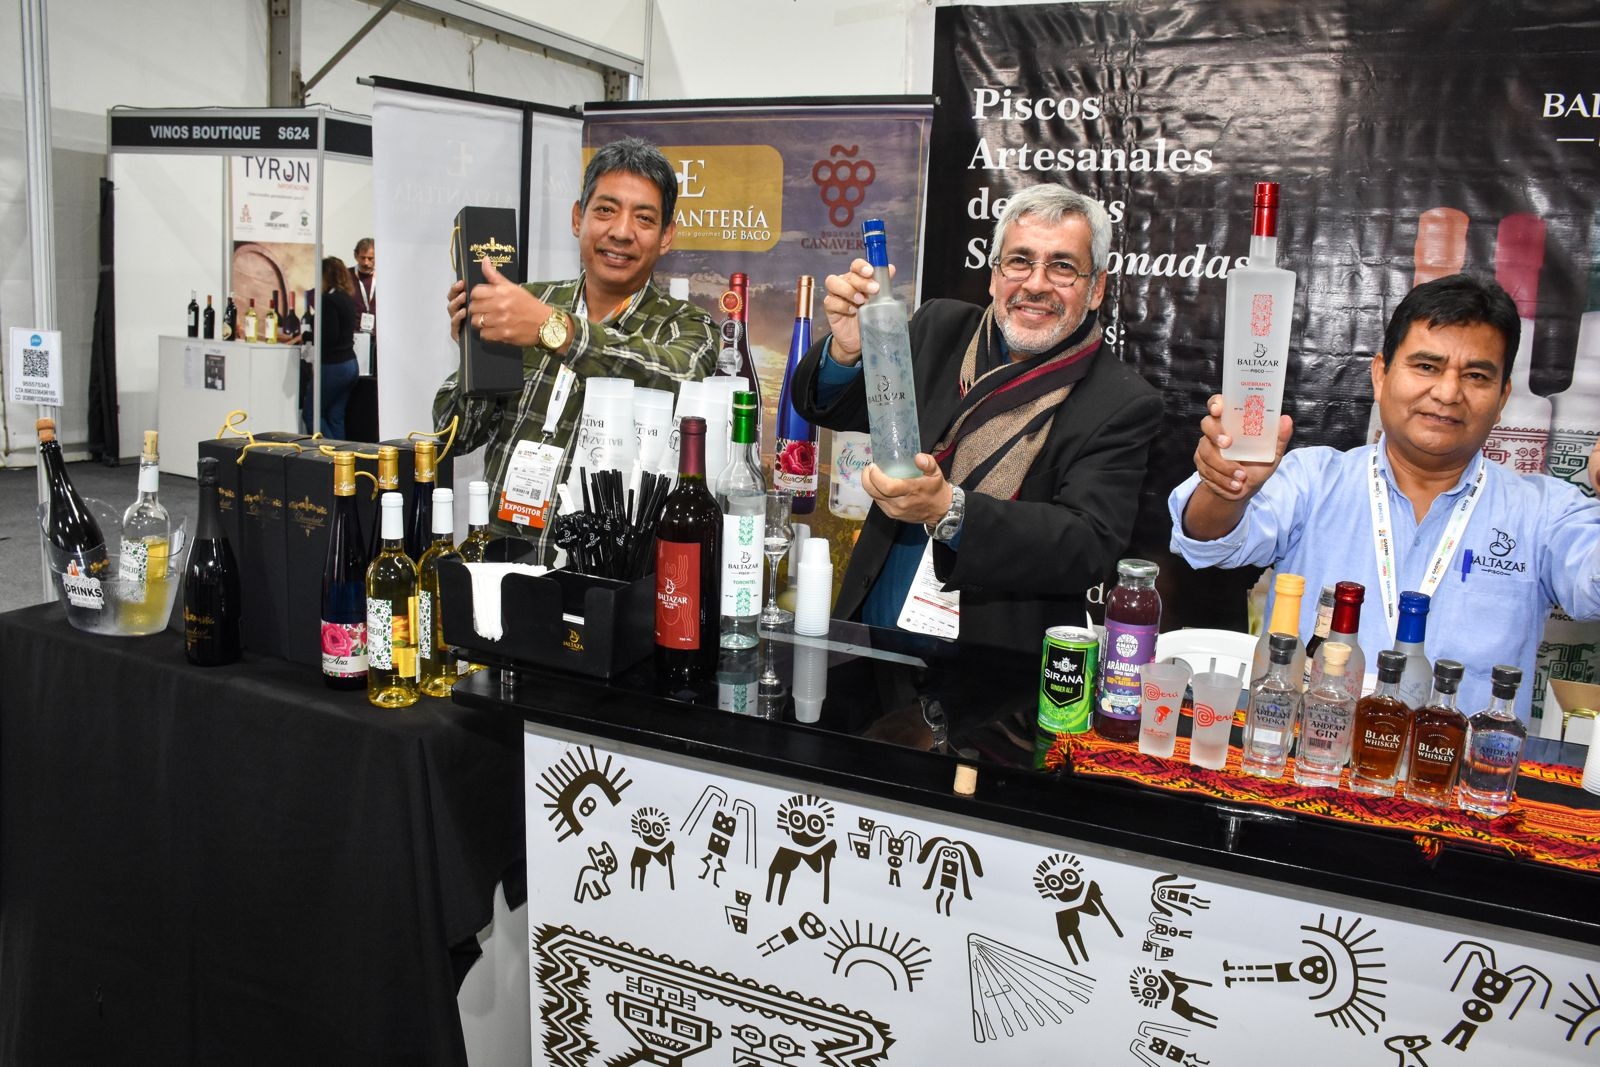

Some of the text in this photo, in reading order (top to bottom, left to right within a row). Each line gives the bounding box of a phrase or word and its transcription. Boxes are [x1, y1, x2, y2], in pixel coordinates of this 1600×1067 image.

[970, 87, 1101, 121] Piscos
[150, 125, 310, 141] VINOS BOUTIQUE S624
[966, 137, 1214, 174] Artesanales
[722, 230, 737, 241] DE
[740, 230, 771, 241] BACO
[1237, 358, 1279, 367] BALTAZAR
[504, 503, 541, 517] EXPOSITOR
[64, 583, 104, 599] DRINKS
[657, 592, 688, 605] BALTAZAR
[1106, 659, 1141, 674] ARÁNDAN
[1044, 668, 1084, 685] SIRANA
[1050, 683, 1066, 692] GINGER
[1256, 715, 1286, 727] VODKA
[1310, 721, 1347, 732] ANDEAN
[1315, 729, 1339, 739] GIN
[1364, 729, 1401, 743] BLACK
[1364, 738, 1400, 749] WHISKEY
[1418, 742, 1456, 757] BLACK
[1417, 750, 1455, 763] WHISKEY
[1479, 746, 1519, 758] ANDEAN
